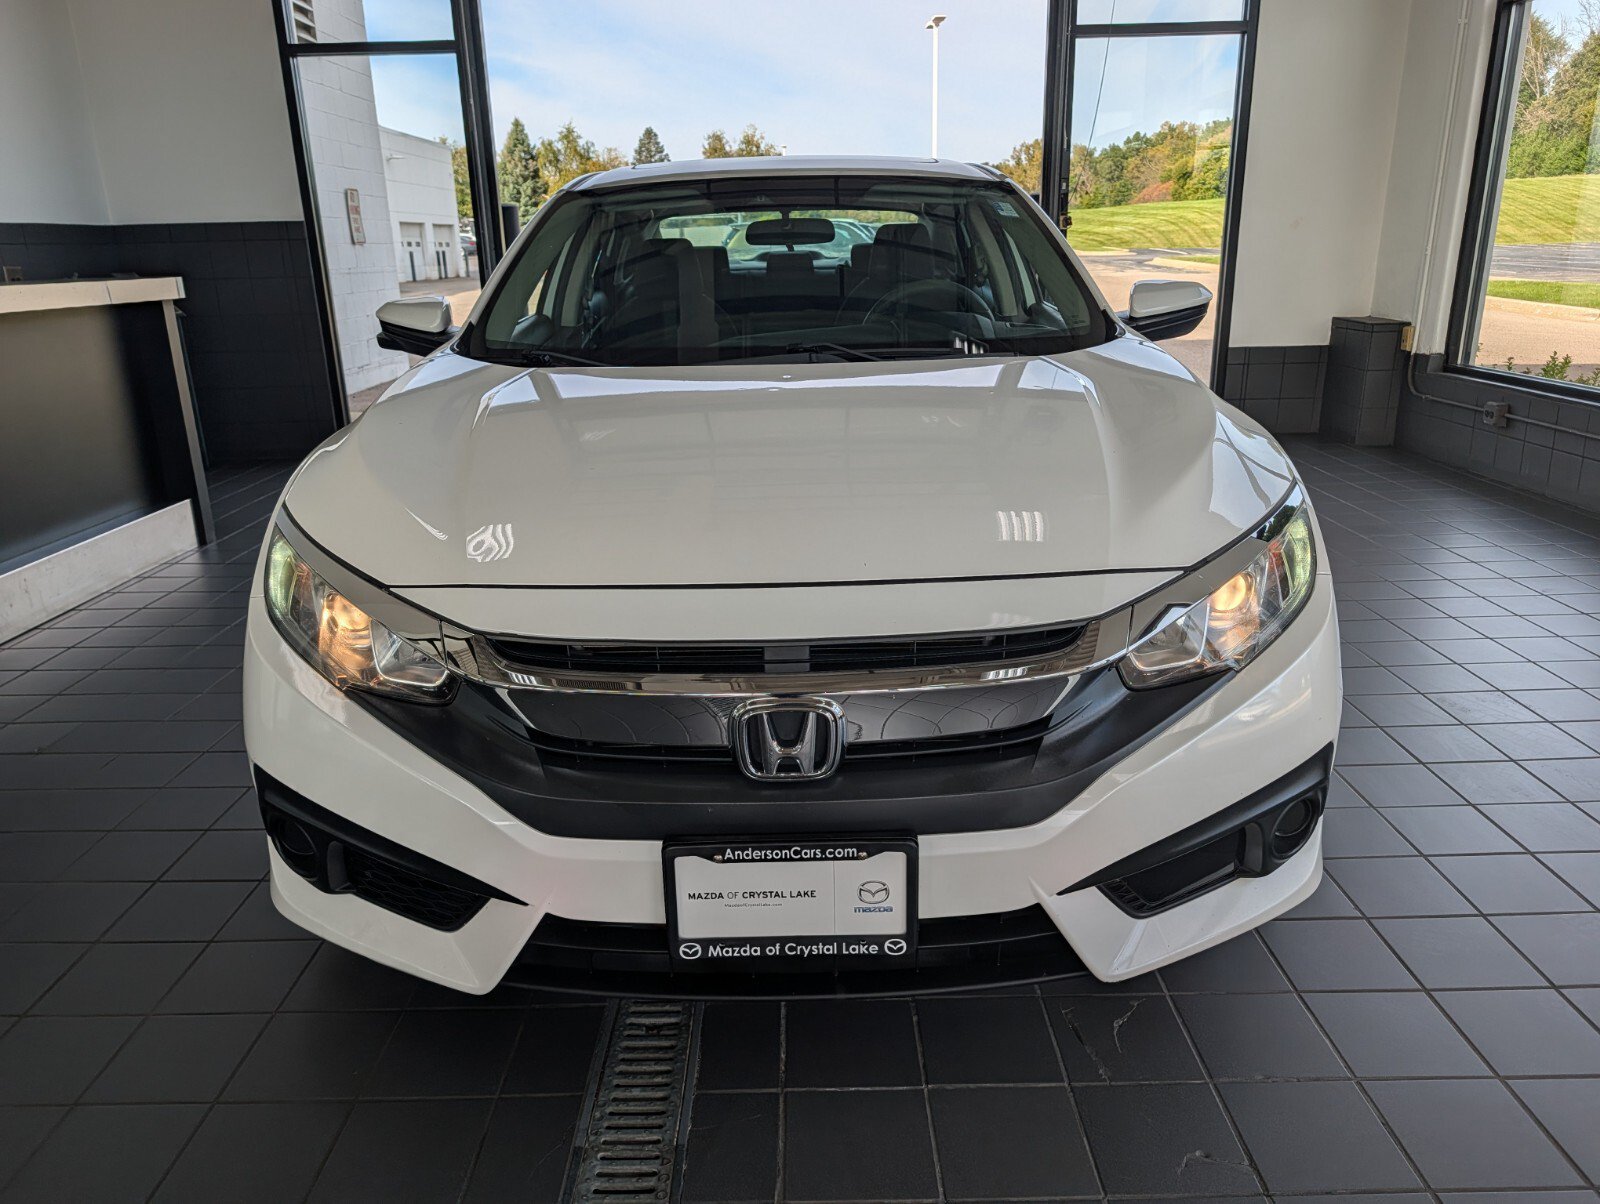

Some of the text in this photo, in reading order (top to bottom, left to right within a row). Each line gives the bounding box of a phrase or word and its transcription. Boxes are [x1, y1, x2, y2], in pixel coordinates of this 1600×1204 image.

[724, 846, 857, 860] AndersonCars.com
[688, 890, 817, 900] MAZDA OF CRYSTAL LAKE
[708, 942, 879, 958] Mazda of Crystal Lake
